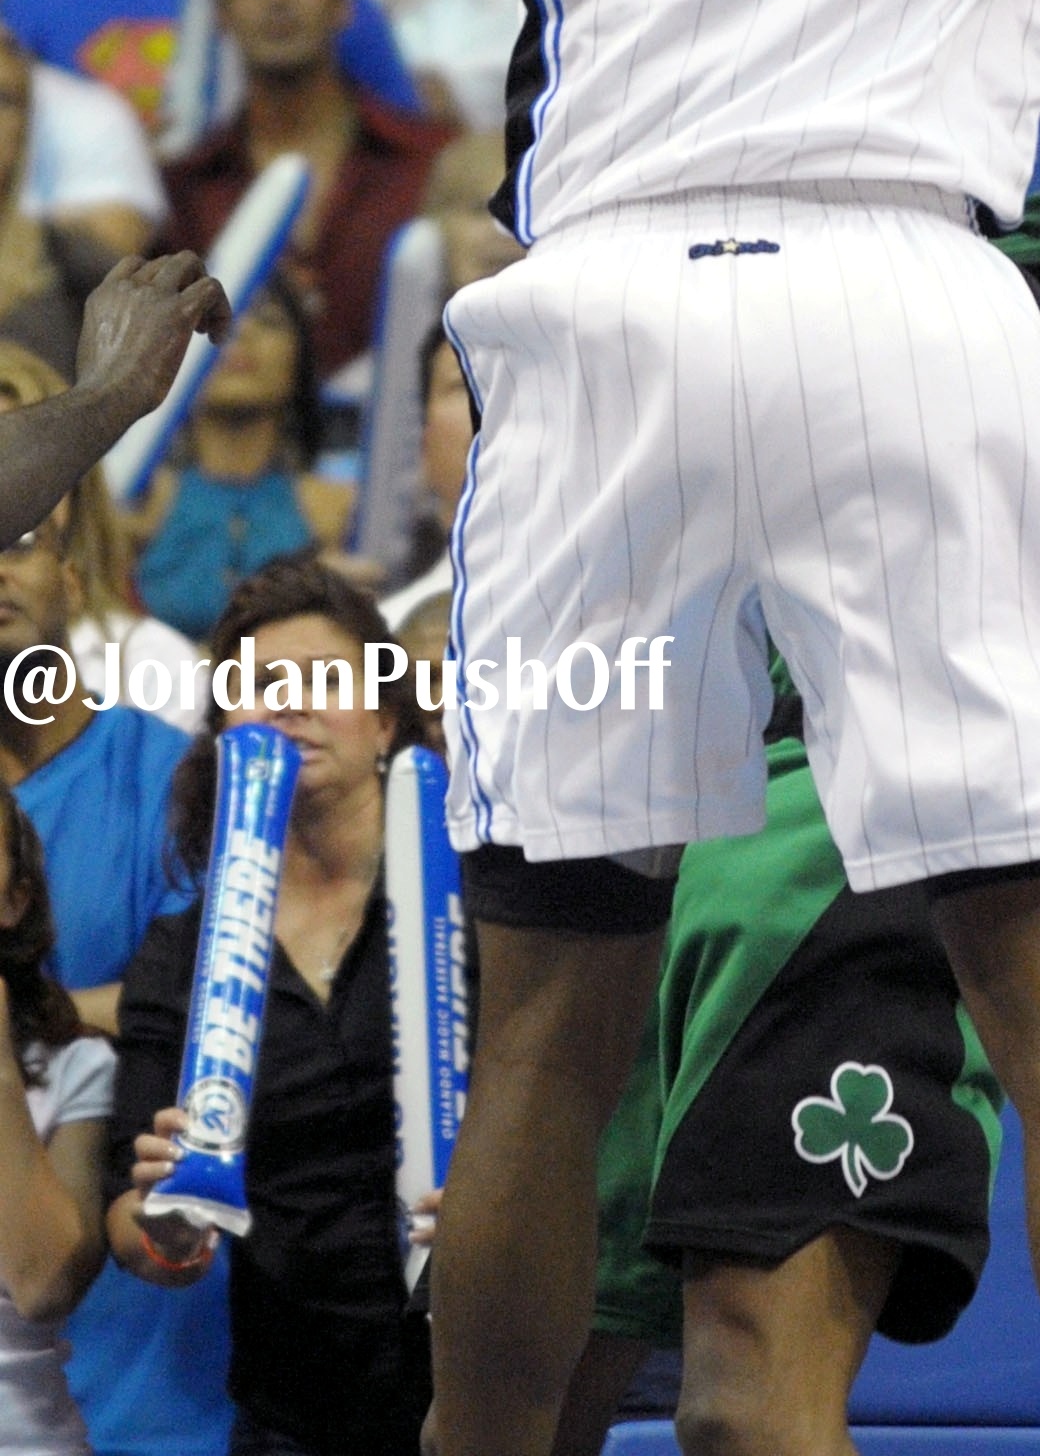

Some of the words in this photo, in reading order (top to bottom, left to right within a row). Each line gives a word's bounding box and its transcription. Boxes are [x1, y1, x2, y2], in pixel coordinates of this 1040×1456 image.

[212, 829, 281, 993] THERE
[434, 917, 449, 1003] BASKETBALL
[203, 996, 258, 1075] BE
[437, 1009, 450, 1062] MAGIC
[440, 1067, 454, 1140] ORLANDO
